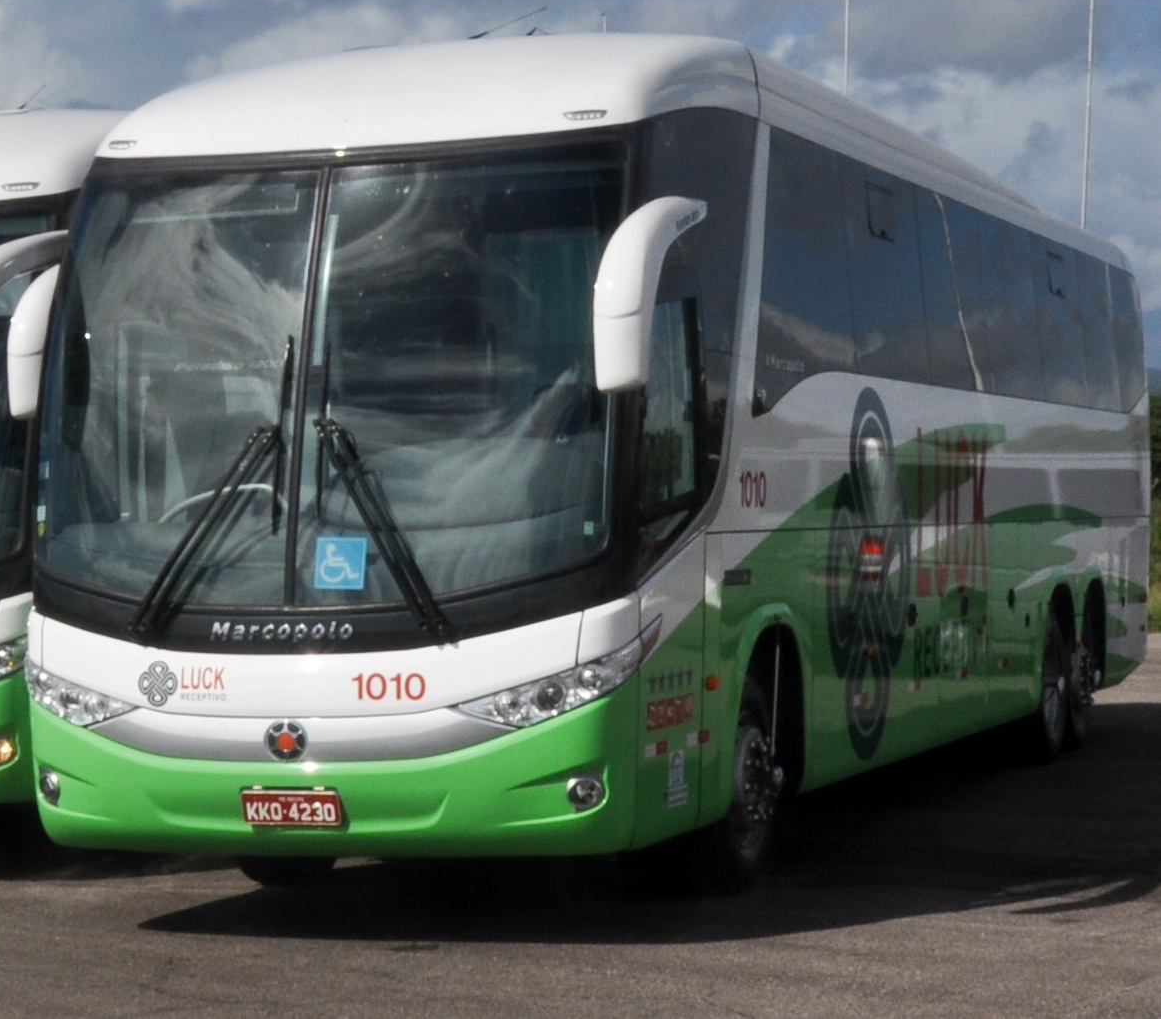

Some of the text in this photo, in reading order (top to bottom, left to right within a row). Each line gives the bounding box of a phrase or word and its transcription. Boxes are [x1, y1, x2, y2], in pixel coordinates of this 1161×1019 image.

[739, 470, 767, 508] 1010
[210, 621, 354, 643] Marcopolo
[180, 666, 226, 690] LUCK
[351, 673, 426, 701] 1010
[180, 692, 226, 702] RECEPTIVO
